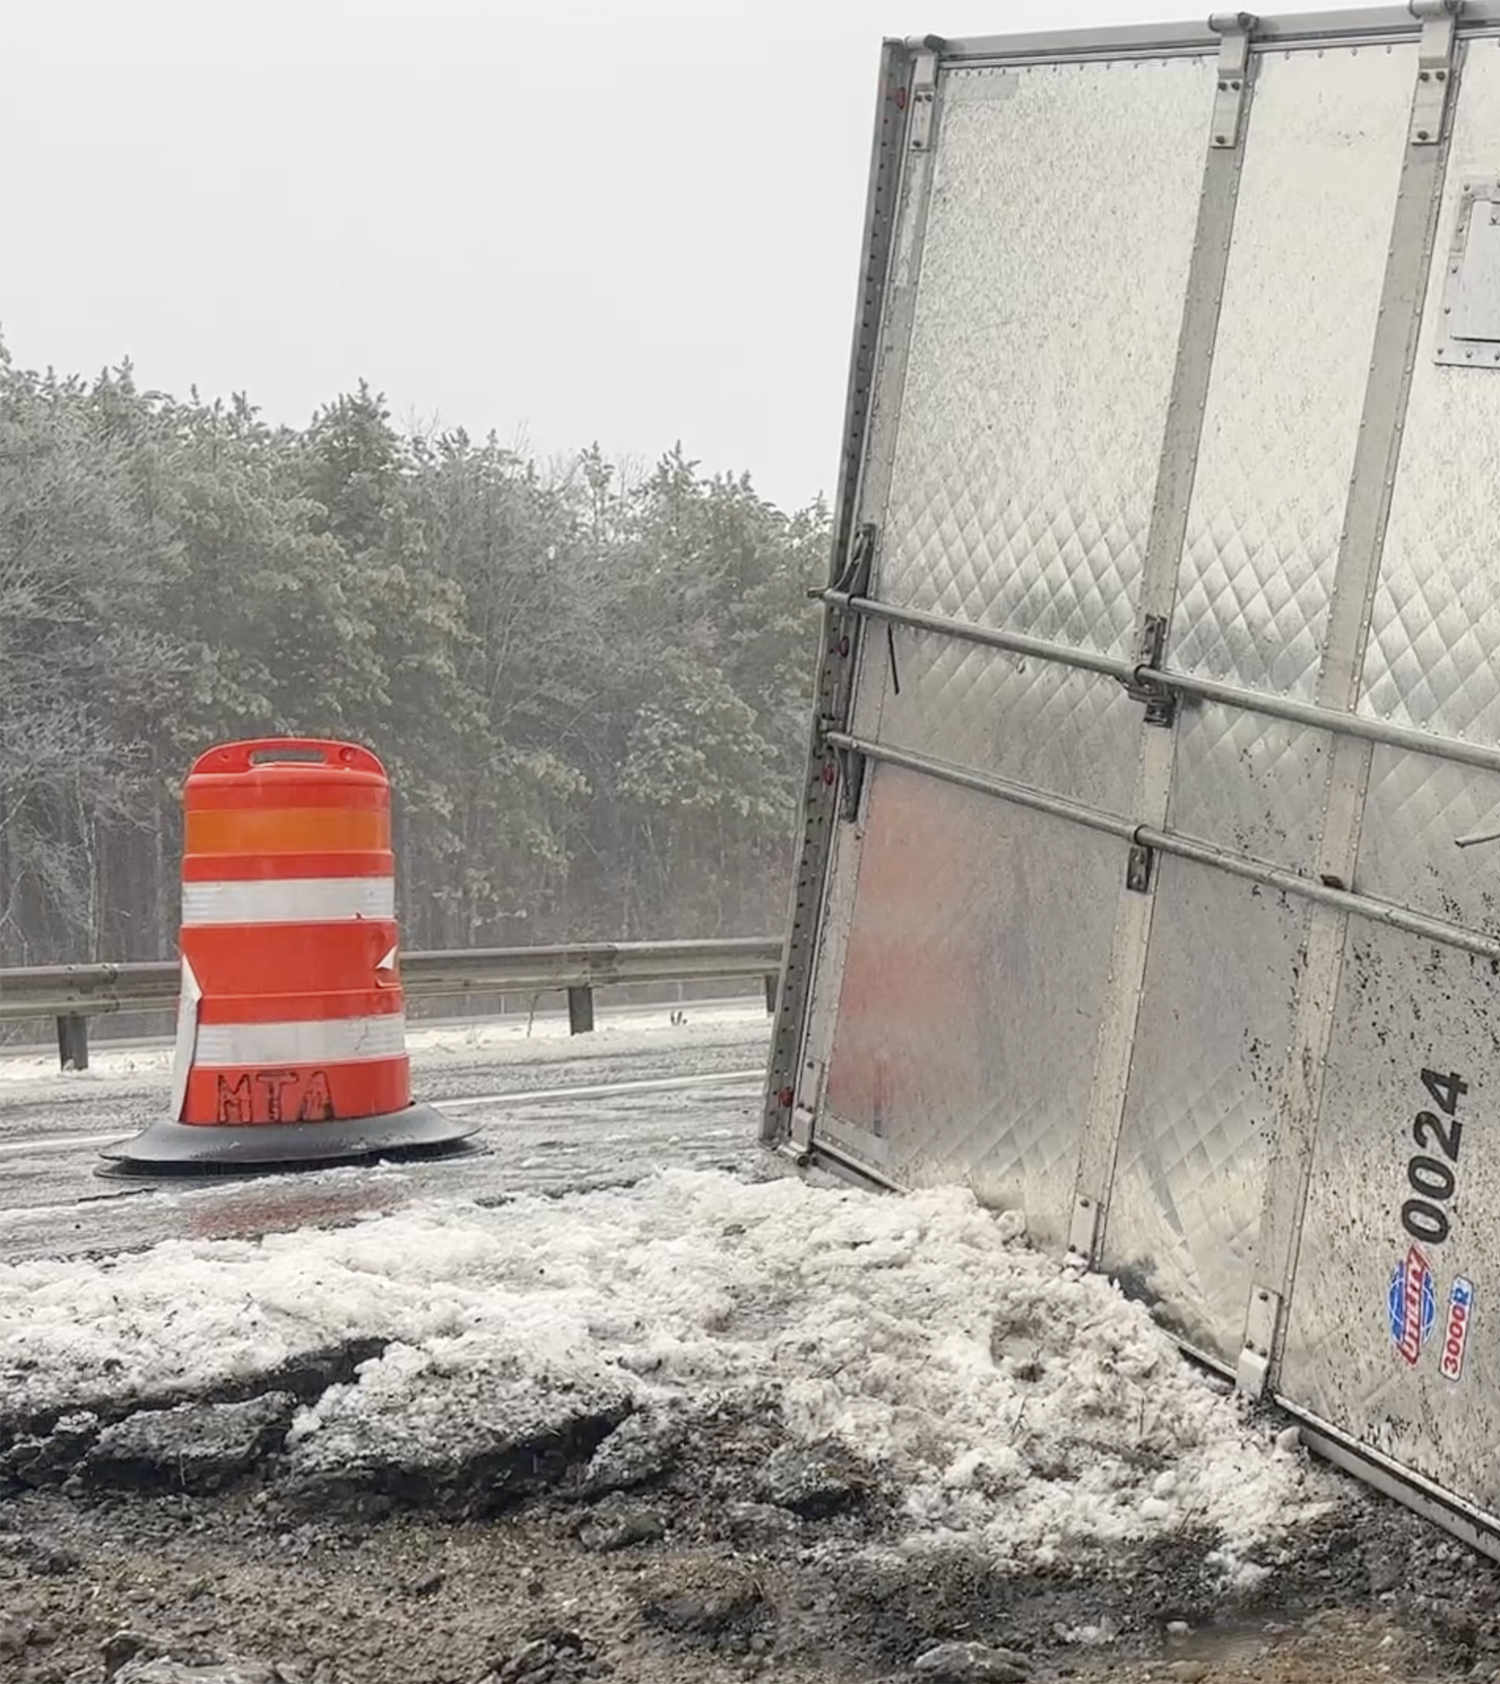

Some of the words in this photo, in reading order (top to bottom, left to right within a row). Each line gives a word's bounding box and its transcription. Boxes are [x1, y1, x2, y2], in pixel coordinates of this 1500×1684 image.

[217, 1070, 336, 1125] MTA
[1401, 1068, 1468, 1244] 0024
[1401, 1251, 1425, 1359] UTILITY
[1443, 1287, 1470, 1375] 3000R
